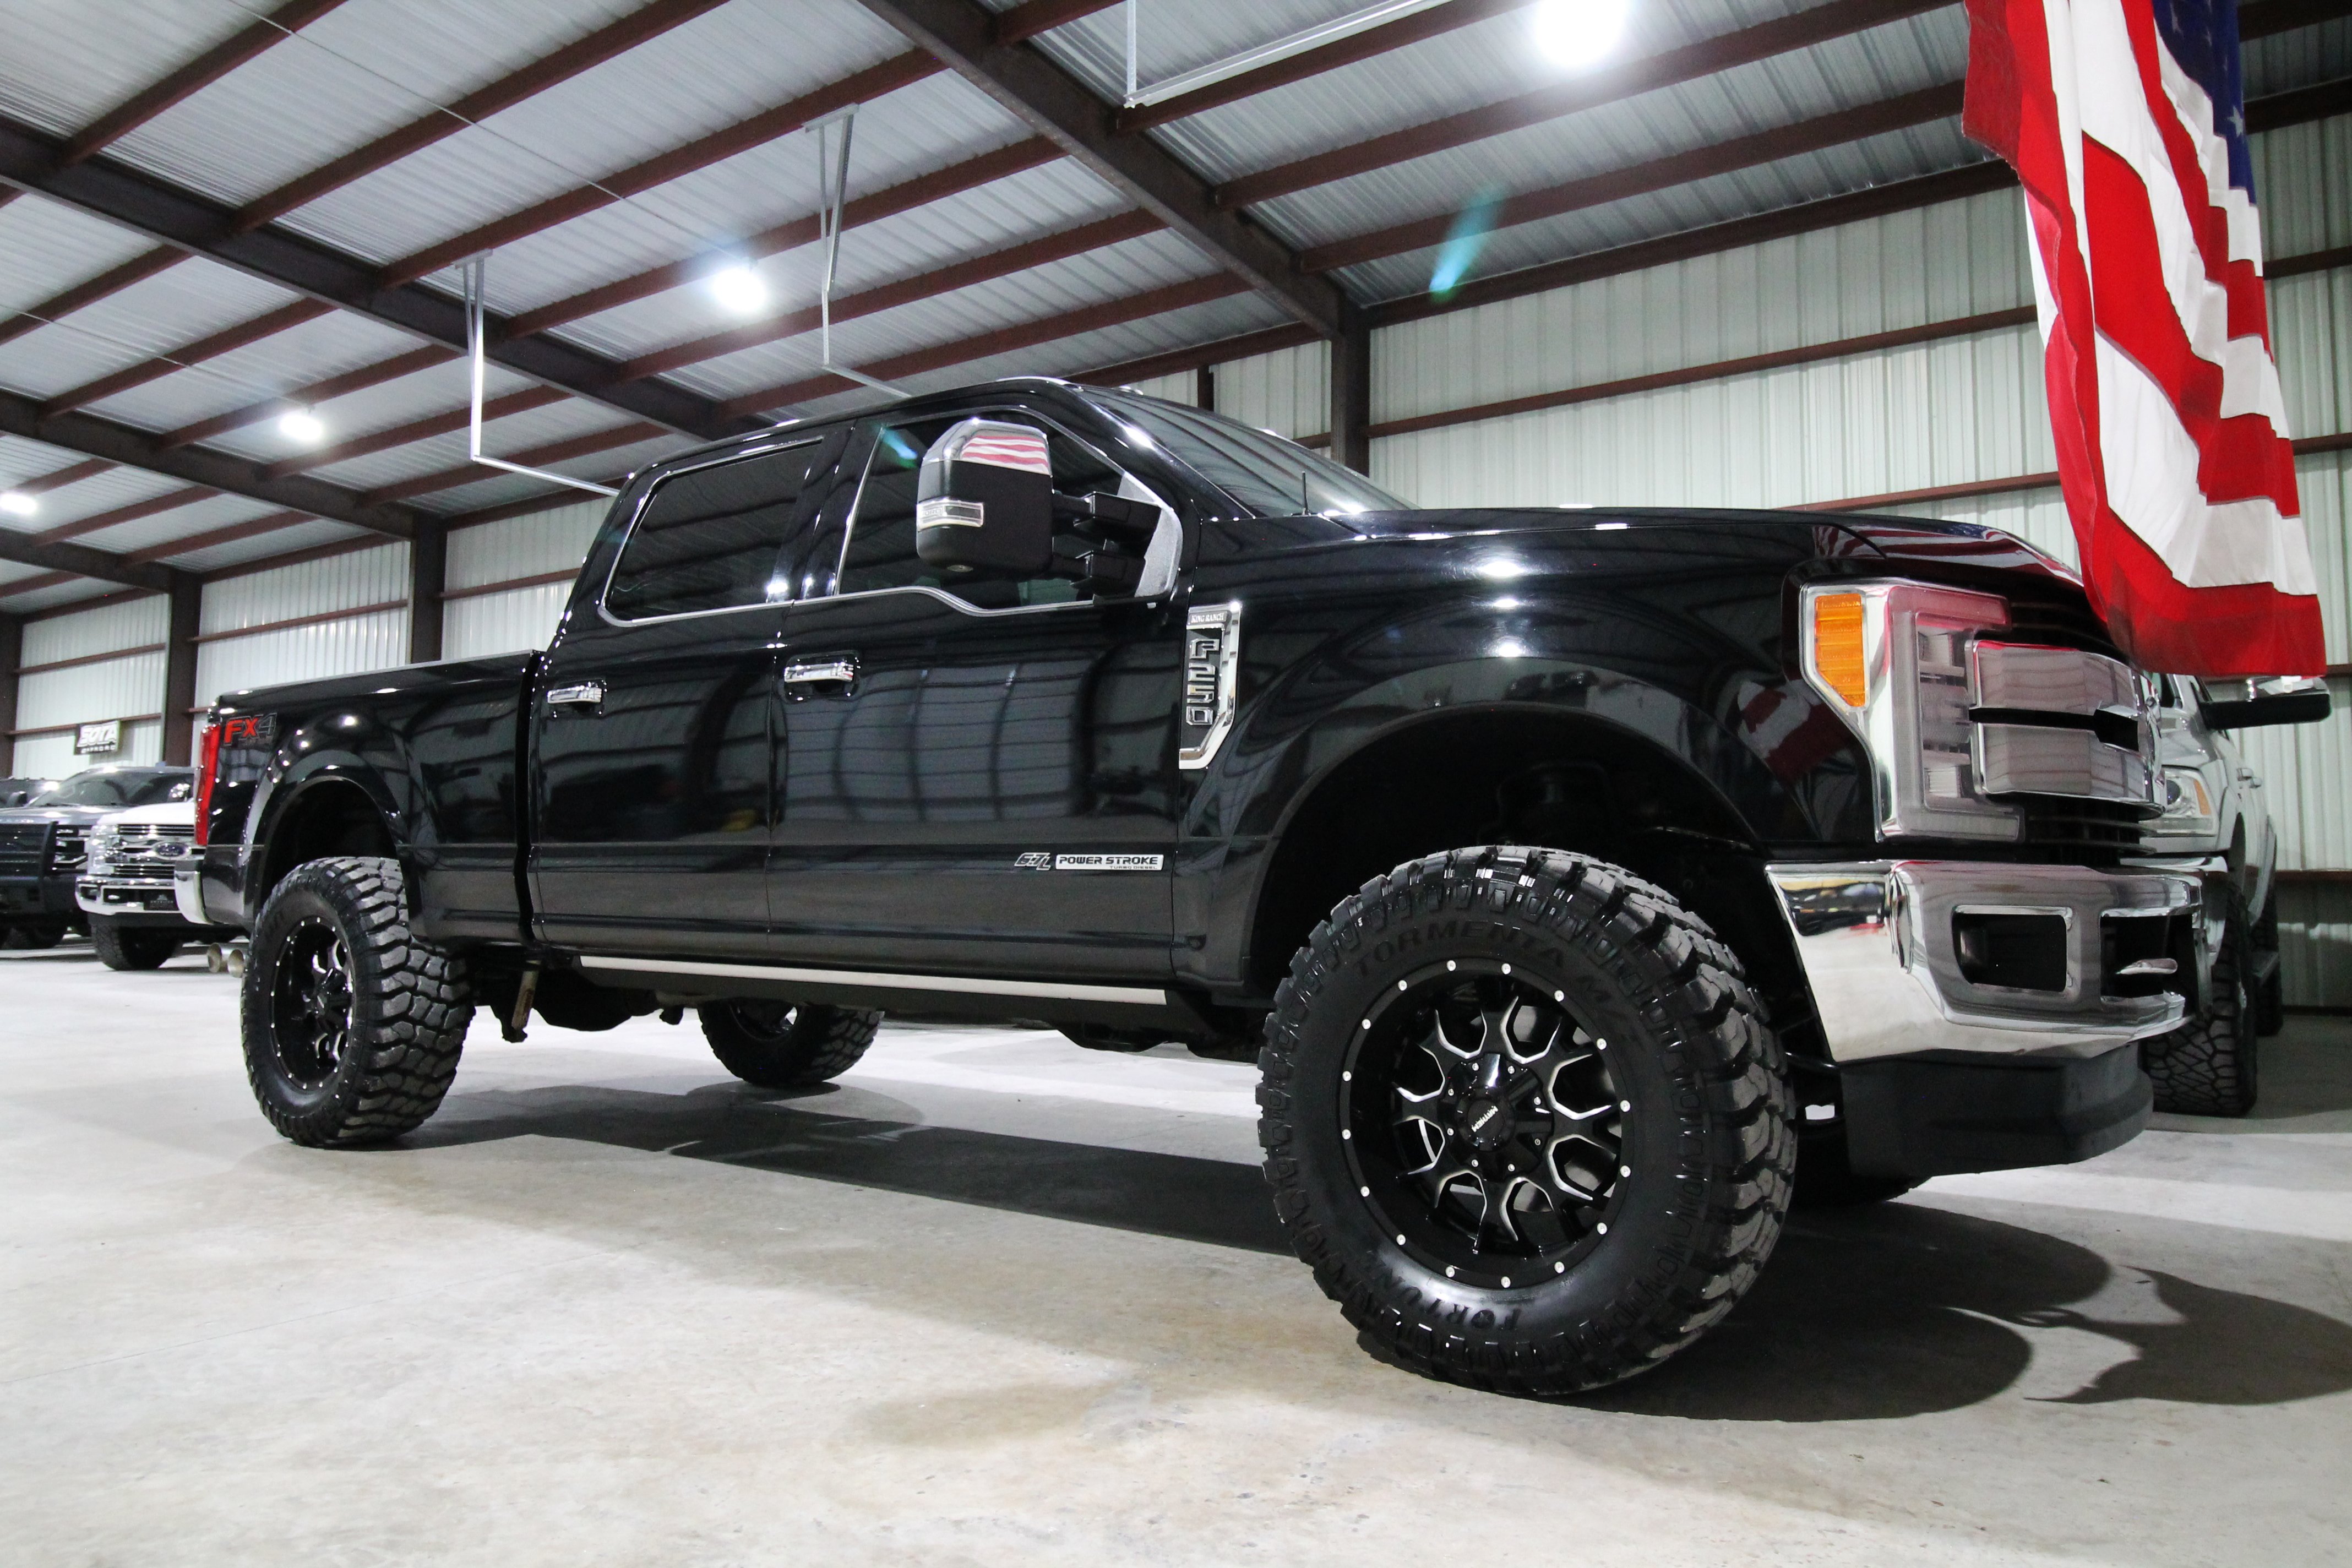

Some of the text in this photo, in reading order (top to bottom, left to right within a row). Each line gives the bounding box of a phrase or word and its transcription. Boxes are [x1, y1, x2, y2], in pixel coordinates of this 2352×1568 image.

[1191, 613, 1224, 623] KING RANCH
[77, 721, 118, 747] SOTA
[224, 712, 277, 746] FX4
[1014, 852, 1158, 870] 6.7L POWER STROKE
[1354, 920, 1564, 977] TORMENTA
[1471, 1106, 1499, 1133] MAYHEM
[1364, 1262, 1521, 1331] FORTUN
